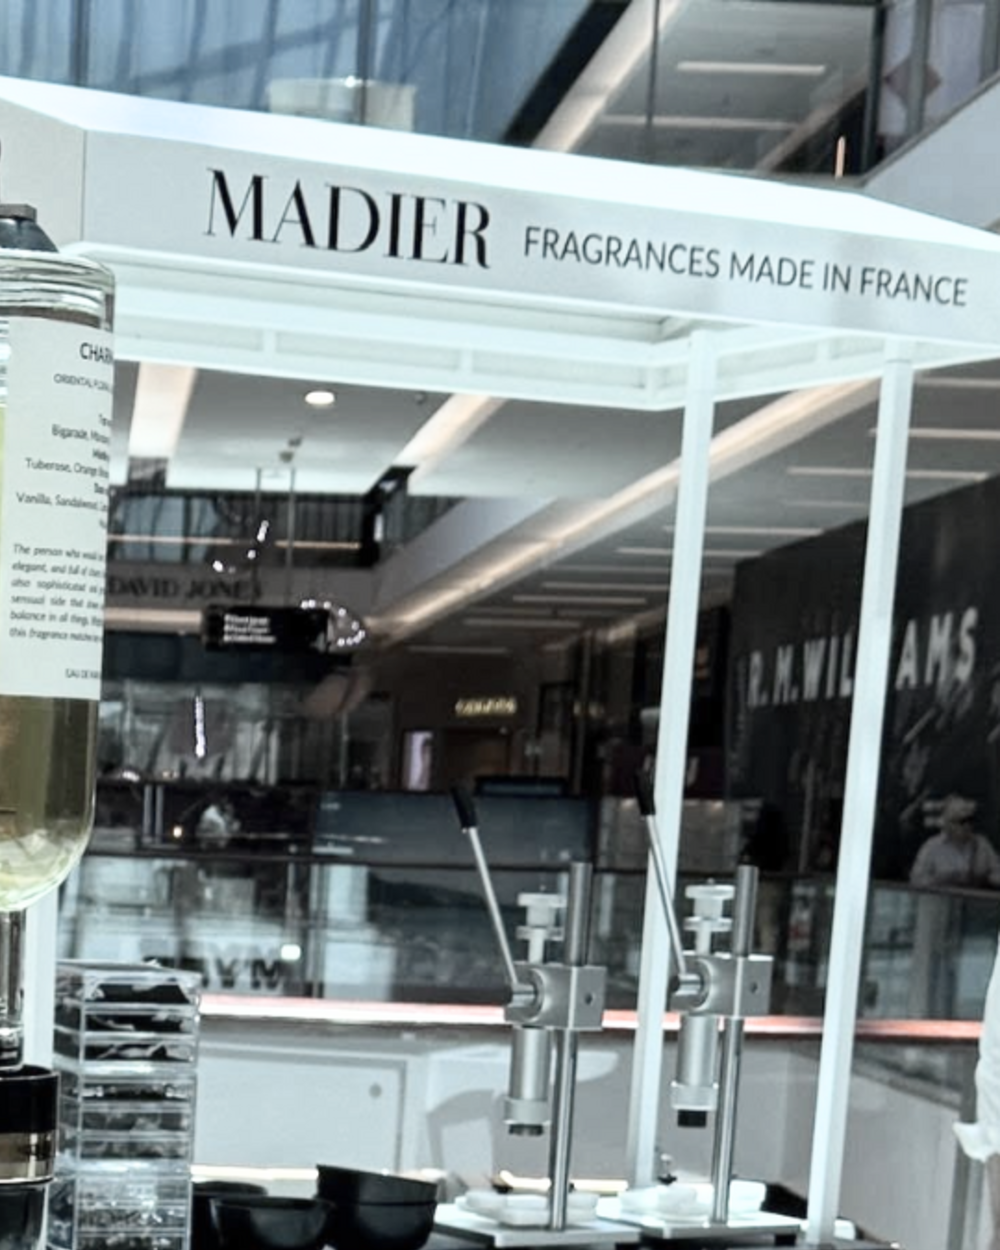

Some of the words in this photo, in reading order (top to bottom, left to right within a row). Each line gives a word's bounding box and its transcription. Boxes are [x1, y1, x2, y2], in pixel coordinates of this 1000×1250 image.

[203, 167, 491, 269] MADIER
[523, 225, 720, 279] FRAGRANCES
[728, 252, 815, 290] MADE
[822, 262, 850, 293] IN
[859, 266, 969, 307] FRANCE
[12, 559, 47, 574] elegant,
[13, 543, 30, 555] The
[33, 547, 63, 558] person
[747, 607, 980, 708] R.M.WILAMS
